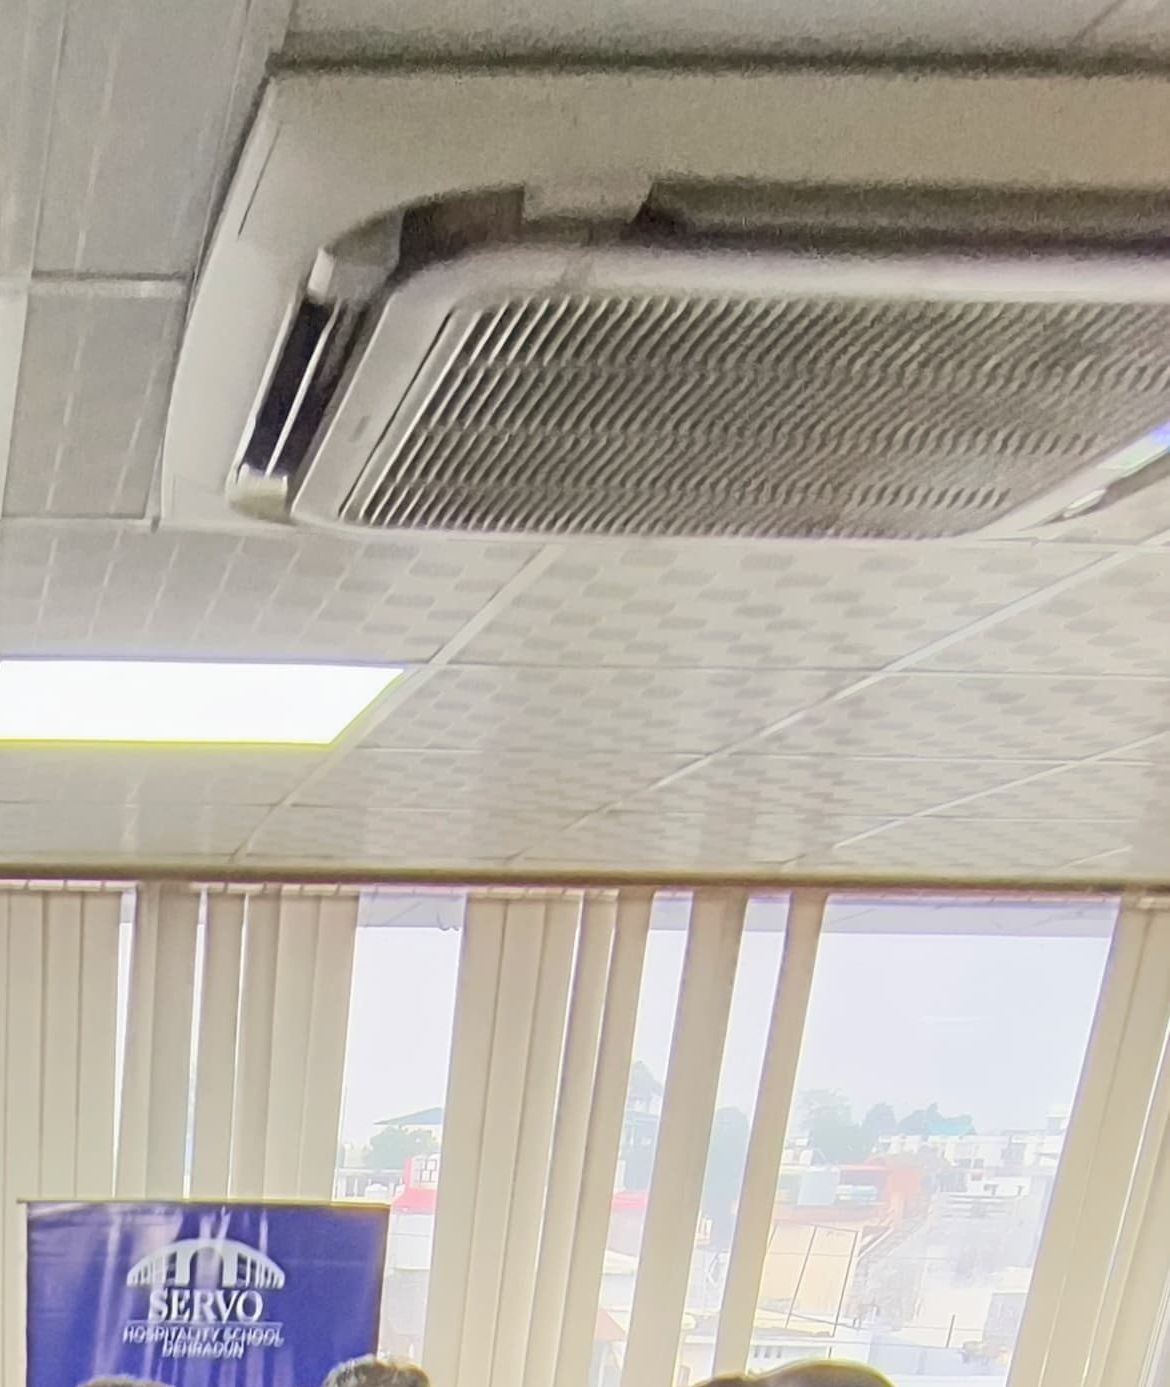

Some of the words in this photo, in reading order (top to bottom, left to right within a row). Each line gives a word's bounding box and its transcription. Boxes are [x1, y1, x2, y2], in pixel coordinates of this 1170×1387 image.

[148, 1288, 264, 1324] SERVO
[122, 1325, 221, 1344] HOSPITALITY
[222, 1327, 285, 1347] SCHOOL
[162, 1339, 245, 1359] DEHRADUN
